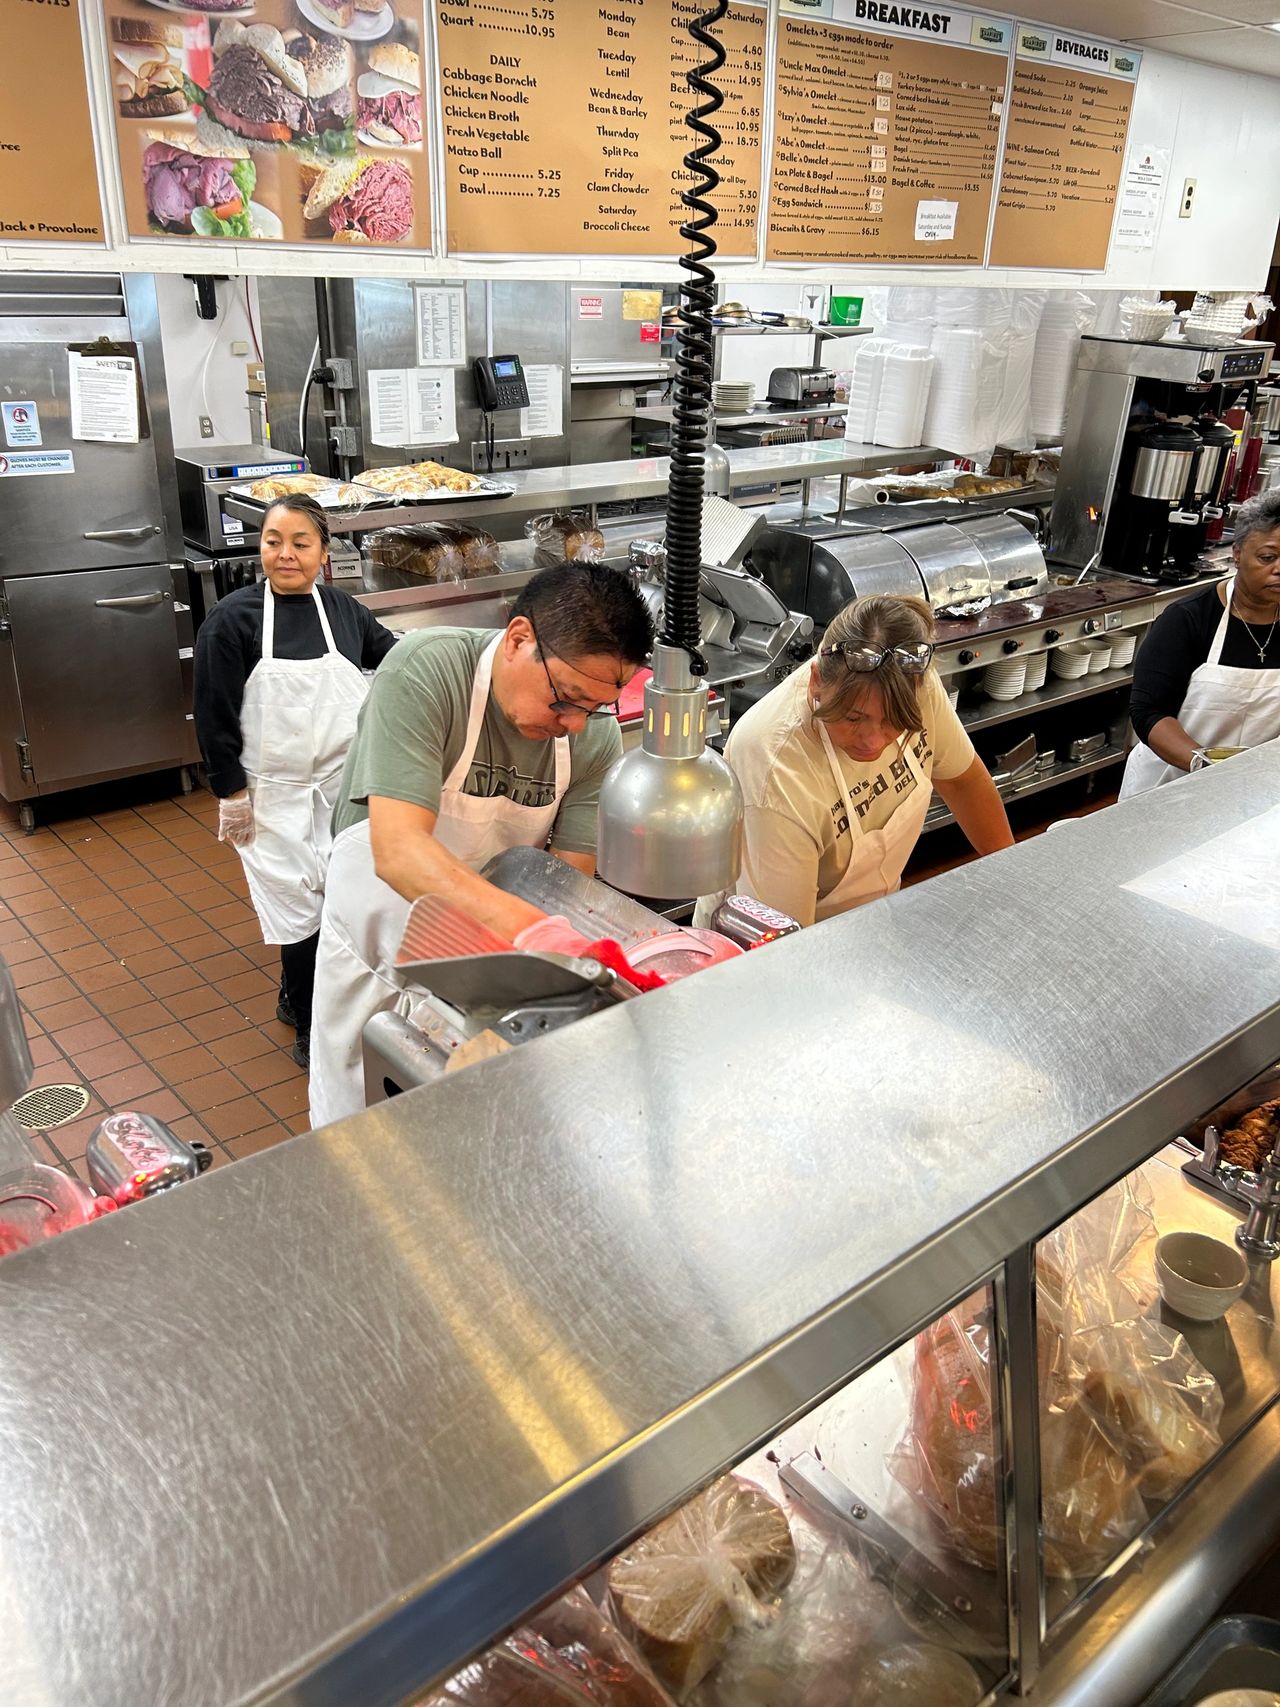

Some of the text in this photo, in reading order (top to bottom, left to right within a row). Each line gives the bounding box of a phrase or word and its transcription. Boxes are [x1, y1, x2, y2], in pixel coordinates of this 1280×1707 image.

[531, 7, 555, 20] 5.75
[599, 9, 636, 26] Monday
[727, 10, 764, 26] Saturday
[855, 0, 951, 34] BREAKFAST
[440, 12, 555, 38] Quart 10.95
[607, 27, 630, 38] Bean
[786, 22, 818, 37] Omelets
[845, 34, 864, 45] made
[865, 37, 872, 46] to
[873, 39, 894, 50] order
[671, 36, 762, 55] Cup 4.80
[1056, 38, 1109, 62] BEVERAGES
[490, 54, 521, 68] DAILY
[598, 48, 636, 64] Tuesday
[671, 53, 762, 71] pint 8.15
[606, 67, 630, 78] Lentil
[784, 60, 803, 71] Uncle
[805, 64, 820, 73] Max
[822, 65, 846, 77] Omelet
[443, 67, 537, 87] Cabbage Borscht
[738, 75, 761, 86] 14.95
[444, 85, 529, 104] Chicken Noodle
[590, 87, 643, 104] Wednesday
[782, 85, 837, 101] Sylvia's Omelet
[445, 105, 520, 122] Chicken Broth
[588, 103, 648, 119] Bean & Barley
[670, 101, 760, 116] Cup 6.85
[669, 117, 759, 132] pint 10.95
[801, 114, 827, 125] Omelet
[446, 125, 530, 142] Fresh Vegetable
[596, 125, 640, 141] Thursday
[0, 141, 21, 151] ree
[737, 137, 758, 147] 18.75
[800, 140, 825, 150] Omelet
[447, 145, 502, 158] Matzo Ball
[602, 146, 639, 158] Split Pea
[780, 152, 802, 163] Belle's
[804, 155, 828, 165] Omelet
[459, 164, 561, 180] Cup 5.25
[605, 168, 634, 181] Friday
[672, 170, 705, 181] Chicken
[775, 168, 833, 181] Lox Plate & Bagel
[587, 182, 650, 194] Clam Chowder
[778, 182, 804, 193] Corned
[804, 185, 820, 194] Beef
[821, 185, 838, 195] Hash
[892, 178, 935, 188] Bagel & Coffee
[460, 183, 560, 198] Bowl 7.25
[671, 188, 684, 196] Cup
[669, 203, 756, 213] pint 7.90
[777, 198, 823, 209] Egg Sandwich
[598, 205, 637, 216] Saturday
[38, 223, 98, 234] Provolone
[583, 221, 650, 232] Broccoli Cheese
[734, 219, 754, 227] 14.95
[770, 223, 800, 233] Biscuits
[806, 225, 825, 235] Gravy
[862, 228, 879, 236] $6.15
